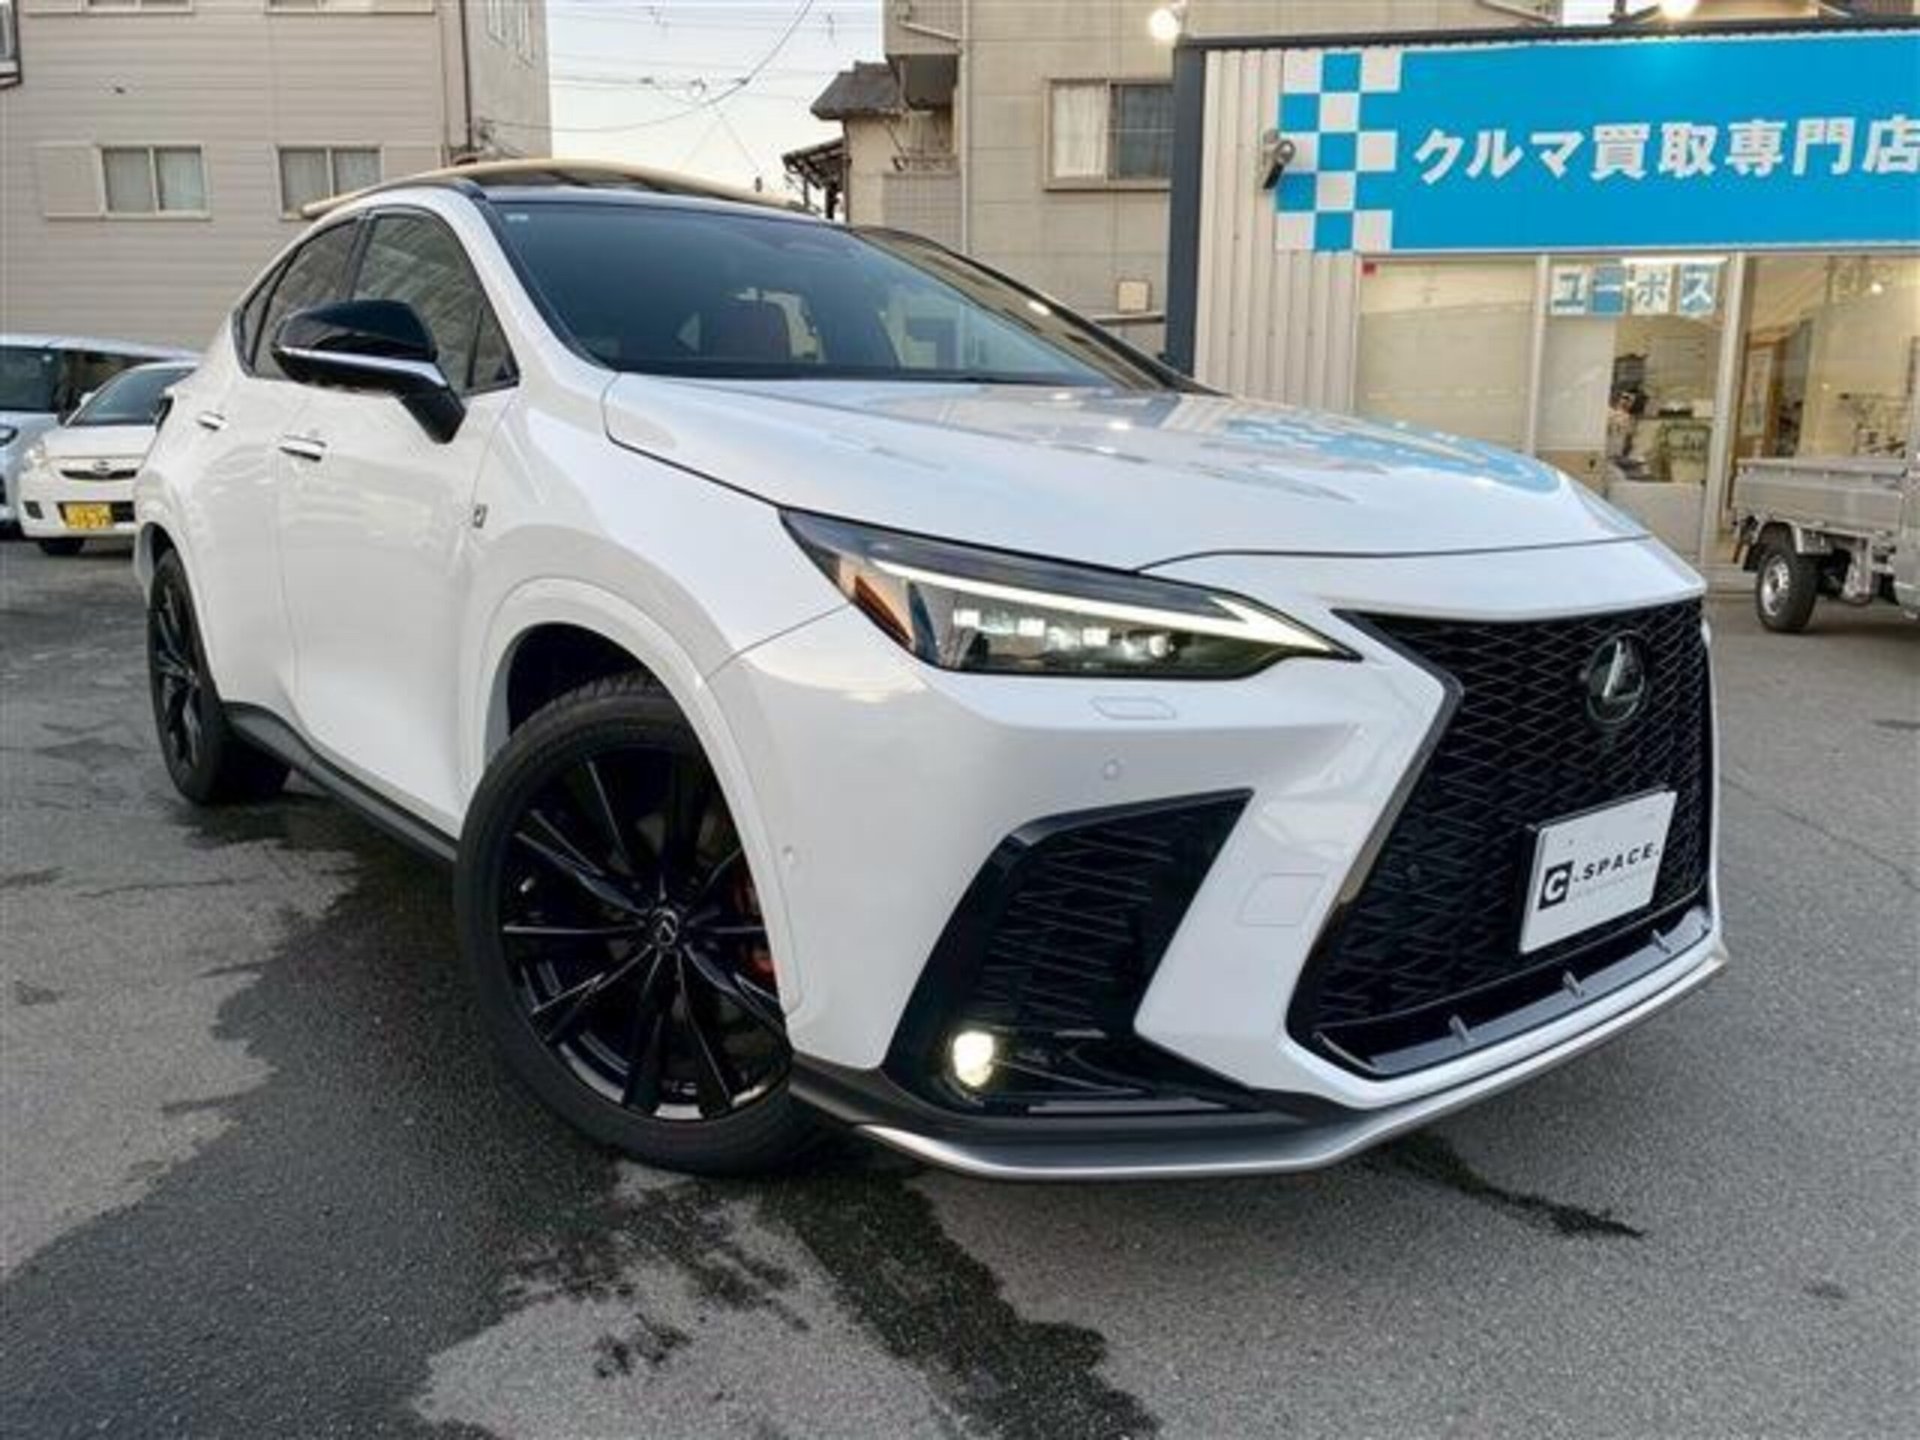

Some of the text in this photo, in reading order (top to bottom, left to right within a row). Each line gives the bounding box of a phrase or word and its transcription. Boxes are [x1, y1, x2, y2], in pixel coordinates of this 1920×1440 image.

[1414, 114, 1920, 186] クルマ買取専門店
